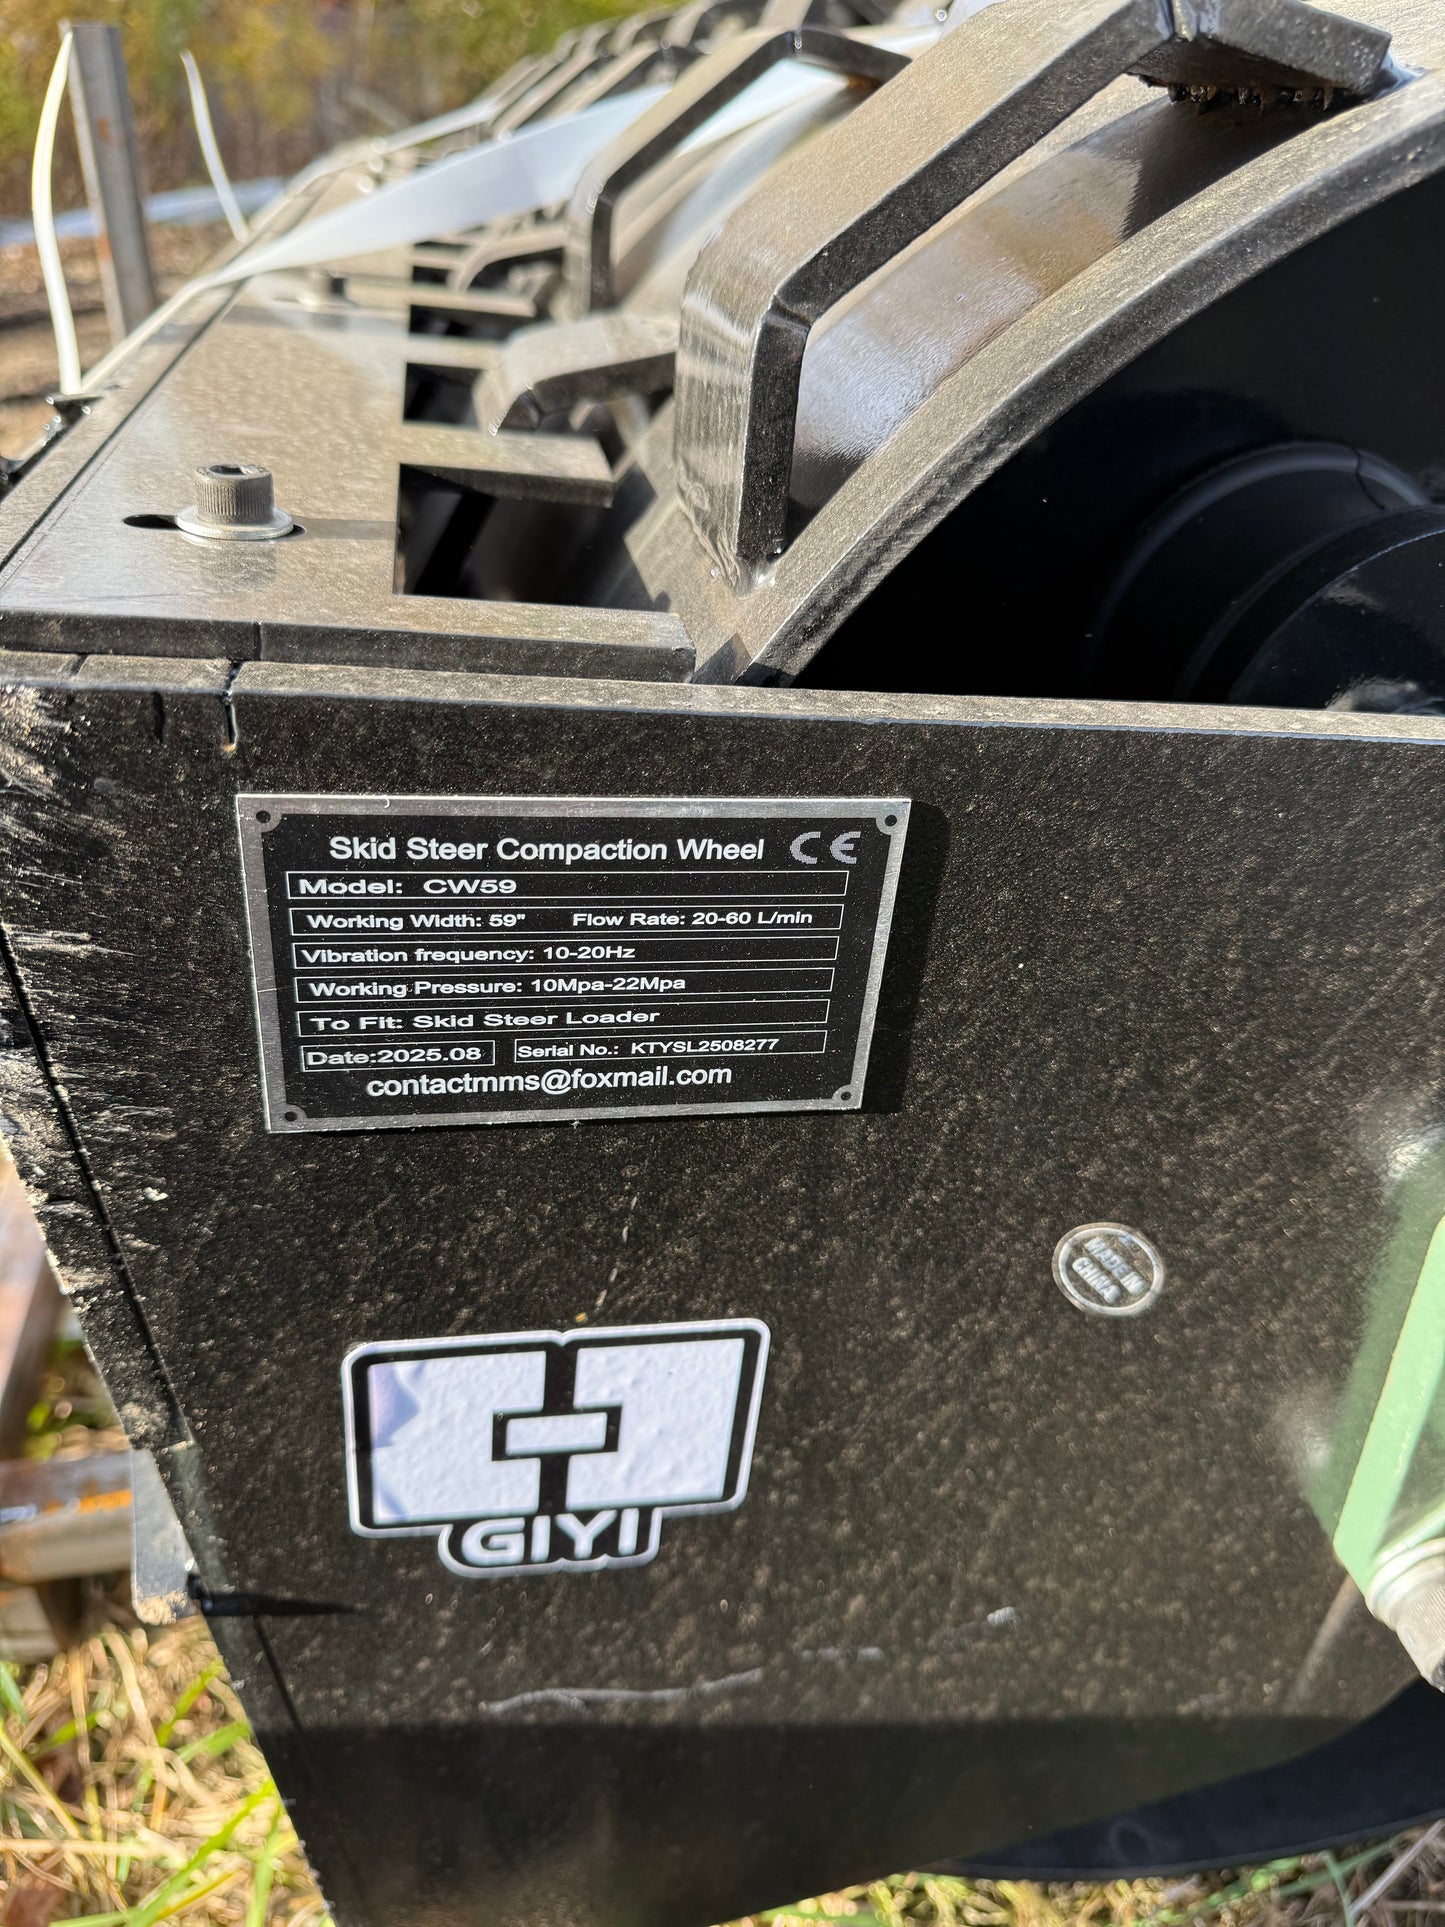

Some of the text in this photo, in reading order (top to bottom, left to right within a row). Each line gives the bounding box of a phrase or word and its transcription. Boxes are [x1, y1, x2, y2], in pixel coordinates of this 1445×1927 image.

[329, 836, 765, 865] Skid Steer Compaction Wheel
[300, 878, 517, 895] Model: CW59
[307, 913, 526, 931] Working Width: 59"
[572, 911, 813, 926] Flow Rate: 20-60 L/min
[301, 945, 636, 964] Vibration frequency: 10-20Hz
[309, 977, 686, 998] Working Pressure: 10Mpa-22Mpa
[310, 1011, 661, 1031] To Fit: Skid Steer Loader
[306, 1048, 482, 1066] Date:2025.08
[517, 1038, 779, 1058] Serial No.: KTYSL2508277
[366, 1066, 732, 1097] contactmms@foxmail.com
[1084, 1237, 1131, 1280] MADE
[1072, 1257, 1120, 1304] CHINA
[461, 1508, 640, 1565] GIYI
